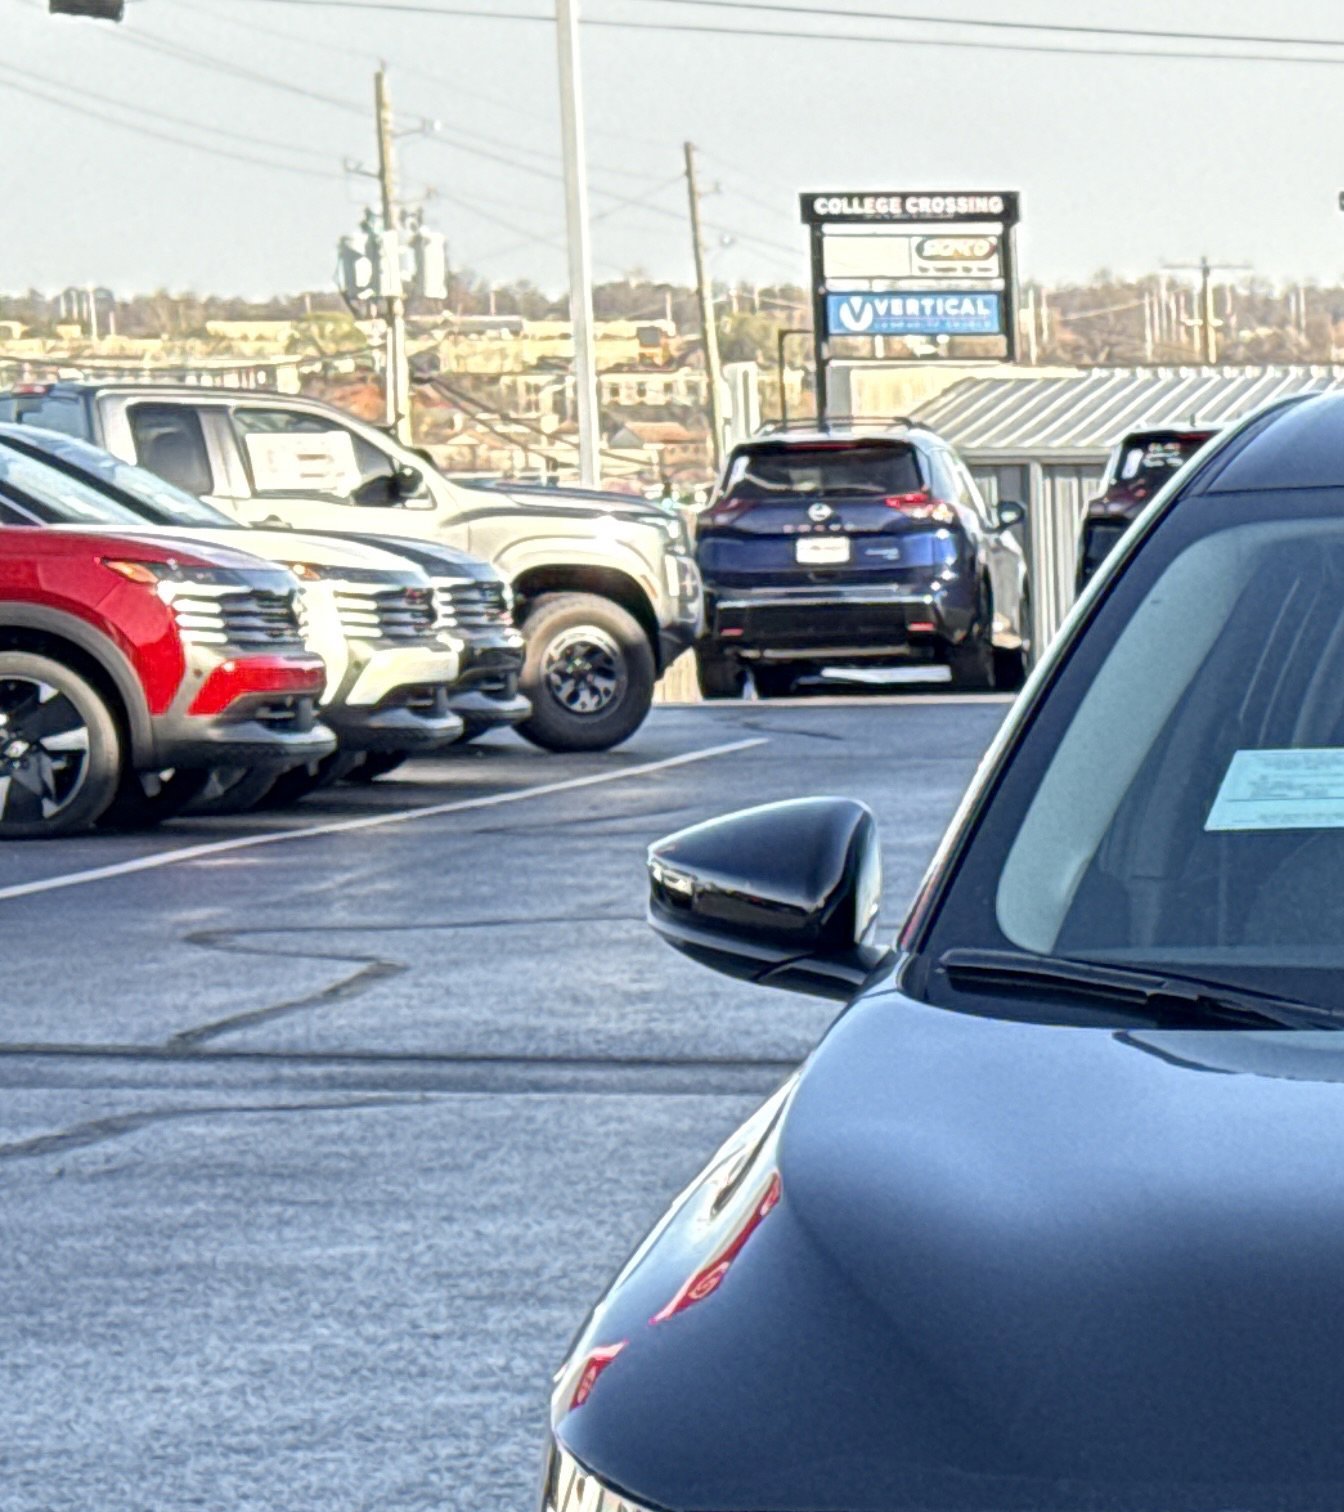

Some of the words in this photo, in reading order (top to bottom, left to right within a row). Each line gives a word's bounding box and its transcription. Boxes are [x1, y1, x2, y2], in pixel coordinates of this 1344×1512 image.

[813, 197, 901, 215] COLLEGE
[905, 196, 1004, 214] CROSSING
[873, 297, 990, 316] VERTICAL
